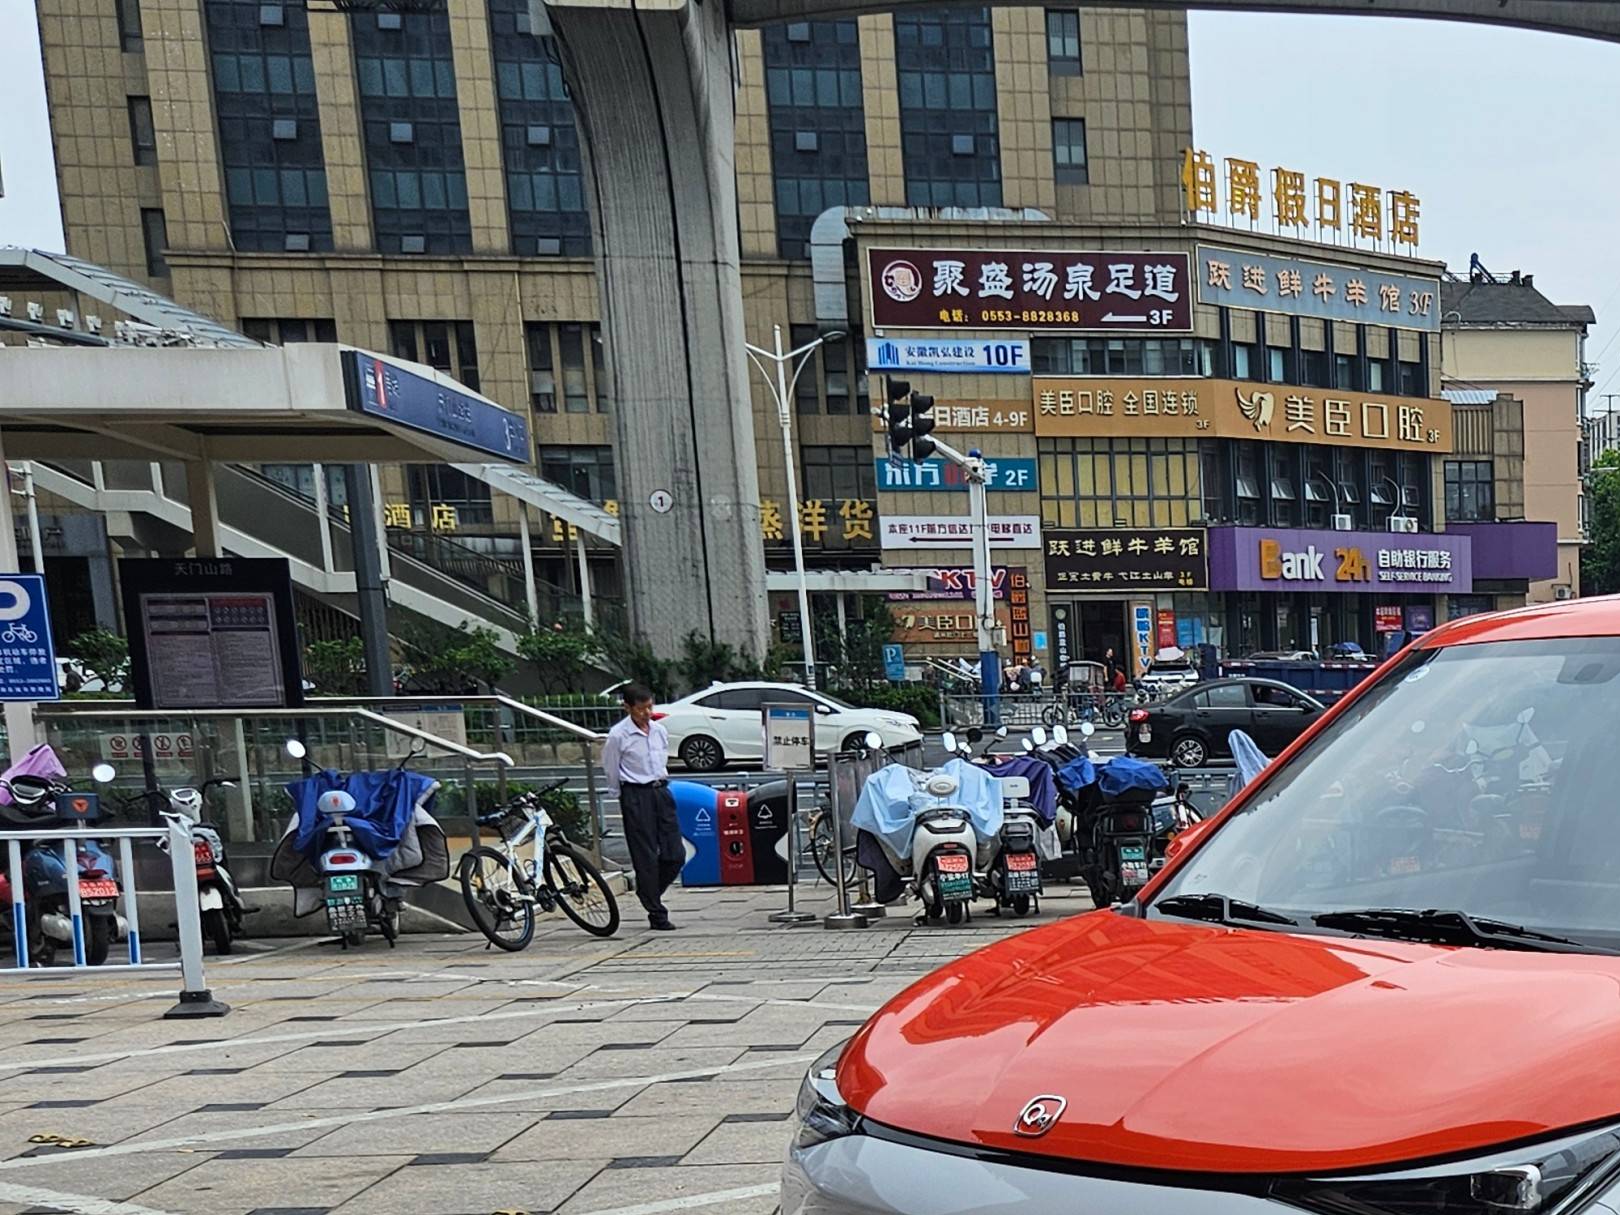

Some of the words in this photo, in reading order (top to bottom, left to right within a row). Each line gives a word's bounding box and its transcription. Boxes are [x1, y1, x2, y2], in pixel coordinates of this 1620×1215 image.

[1182, 147, 1420, 247] 伯爵假日酒店
[932, 259, 1180, 302] 聚盛汤泉足道
[1207, 259, 1401, 313] 跃进鲜牛羊馆
[1408, 289, 1434, 316] 3F
[981, 309, 1080, 323] 0553-8828368
[1149, 309, 1173, 324] 3F
[982, 344, 1023, 366] 10F
[1039, 389, 1114, 416] 美臣口腔
[1123, 389, 1199, 416] 全国连锁
[992, 411, 1028, 427] 4-9F
[1284, 395, 1424, 442] 美臣口腔
[1426, 429, 1441, 444] 3F
[1004, 469, 1028, 486] 2F
[657, 496, 664, 508] 1
[1048, 536, 1200, 557] 跃进鲜牛羊馆
[1259, 538, 1325, 580] Bank
[1378, 549, 1452, 569] 自助银行服务
[773, 735, 809, 747] 禁止停车
